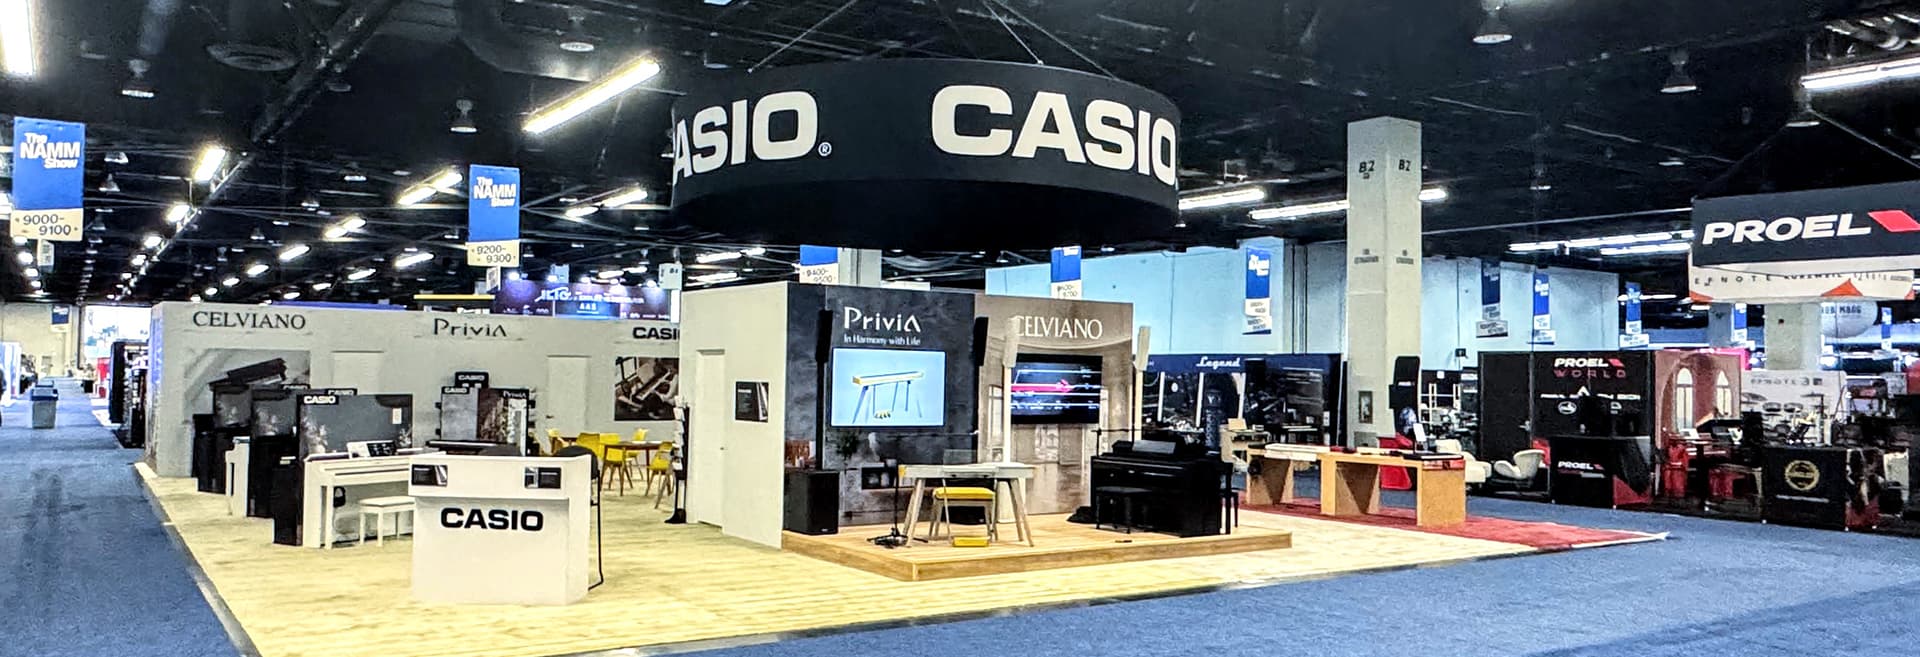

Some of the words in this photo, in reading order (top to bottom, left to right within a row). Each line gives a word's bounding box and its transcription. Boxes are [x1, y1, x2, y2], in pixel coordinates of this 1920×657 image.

[24, 132, 47, 144] The
[932, 85, 1176, 185] CASIO
[20, 142, 80, 158] NAMM
[43, 159, 78, 169] Show
[1359, 160, 1375, 173] B2
[474, 184, 516, 199] NAMM
[23, 214, 64, 225] 9000-
[39, 225, 71, 236] 9100
[1702, 213, 1871, 245] PROEL
[486, 254, 512, 263] 9300
[192, 311, 306, 330] CELVIANO
[632, 326, 680, 341] CASI
[1196, 356, 1241, 369] Legend
[1554, 358, 1609, 368] PROEL
[1554, 368, 1626, 379] WORLD
[303, 395, 337, 404] CASIO
[1557, 461, 1594, 470] PROEL
[440, 507, 544, 532] CASIO
